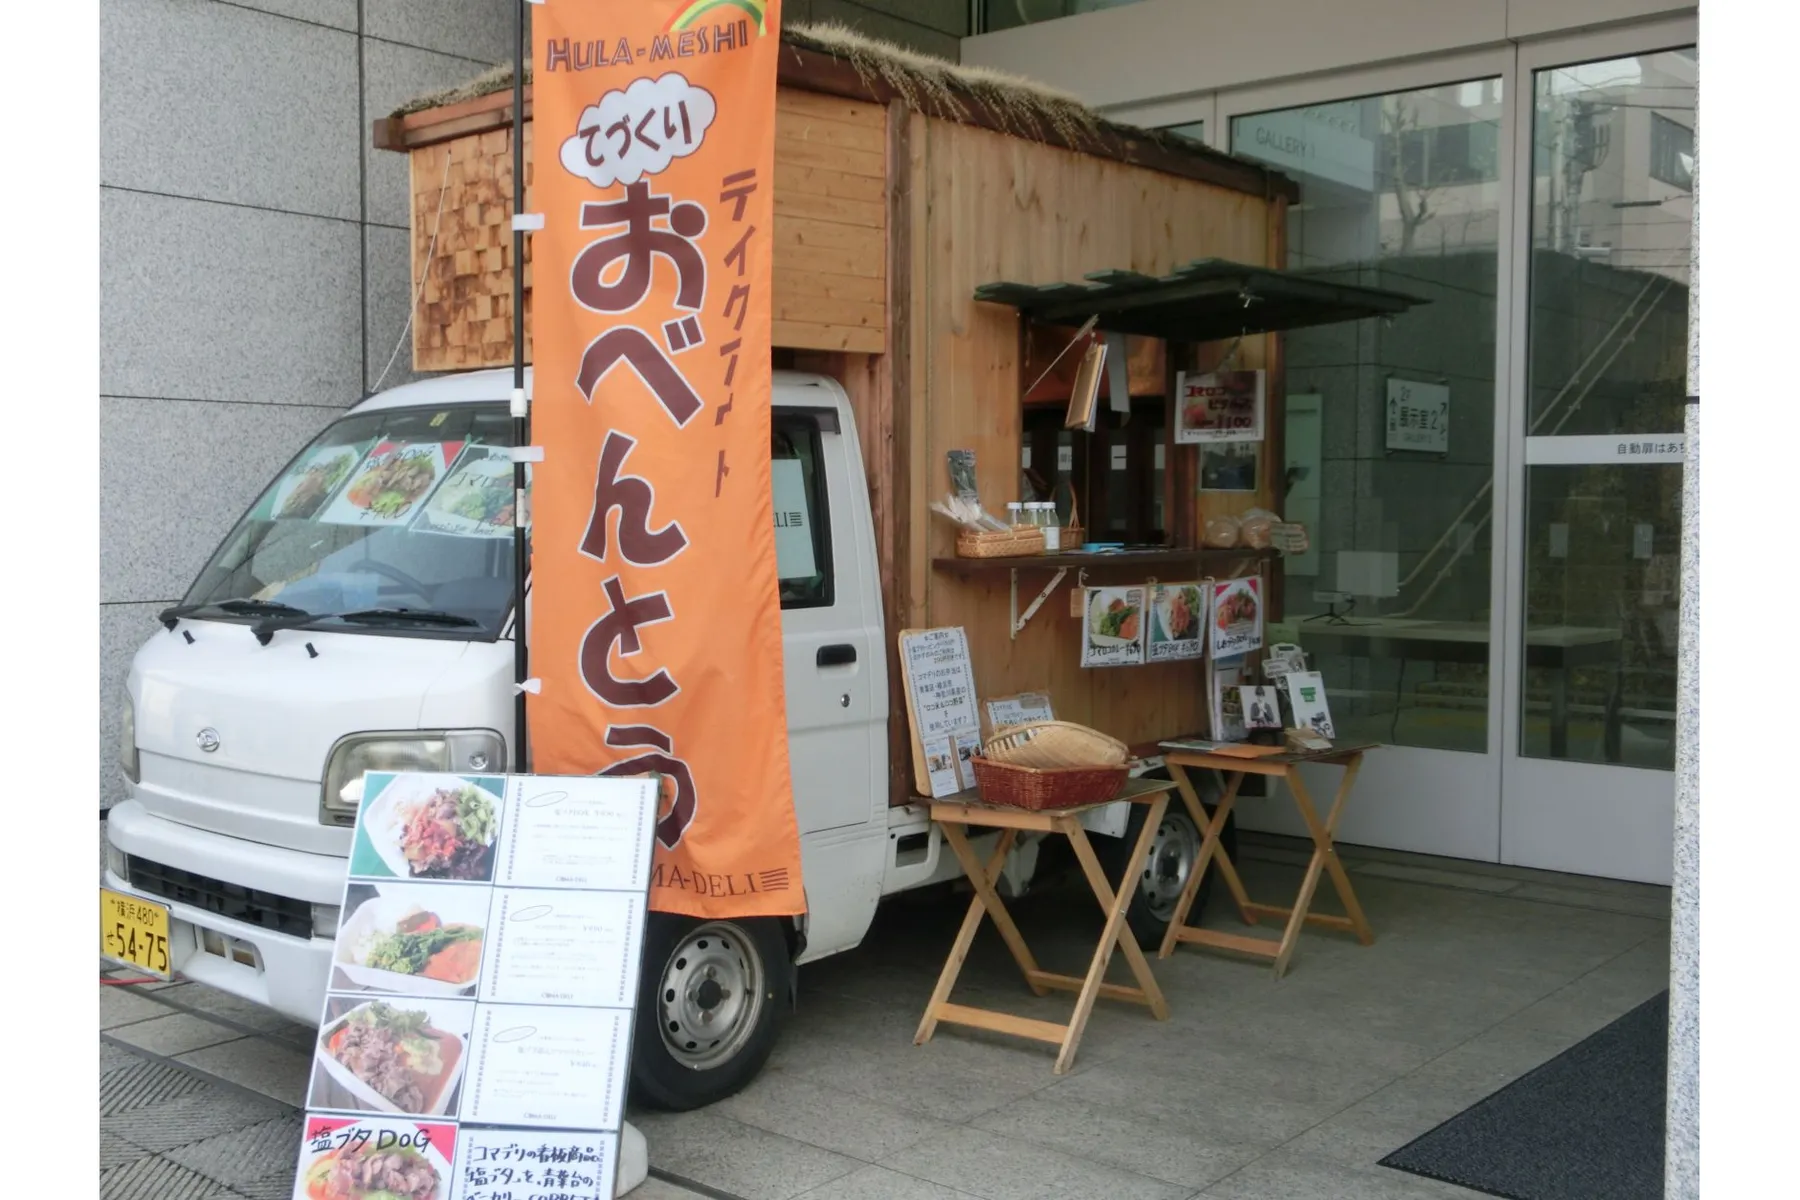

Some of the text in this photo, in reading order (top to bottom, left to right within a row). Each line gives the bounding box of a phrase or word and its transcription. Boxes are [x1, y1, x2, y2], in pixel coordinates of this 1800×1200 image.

[546, 19, 749, 72] HULA-MESHI
[579, 100, 692, 167] てづくり
[1256, 126, 1307, 157] GALLERY
[569, 178, 708, 849] おべんとう
